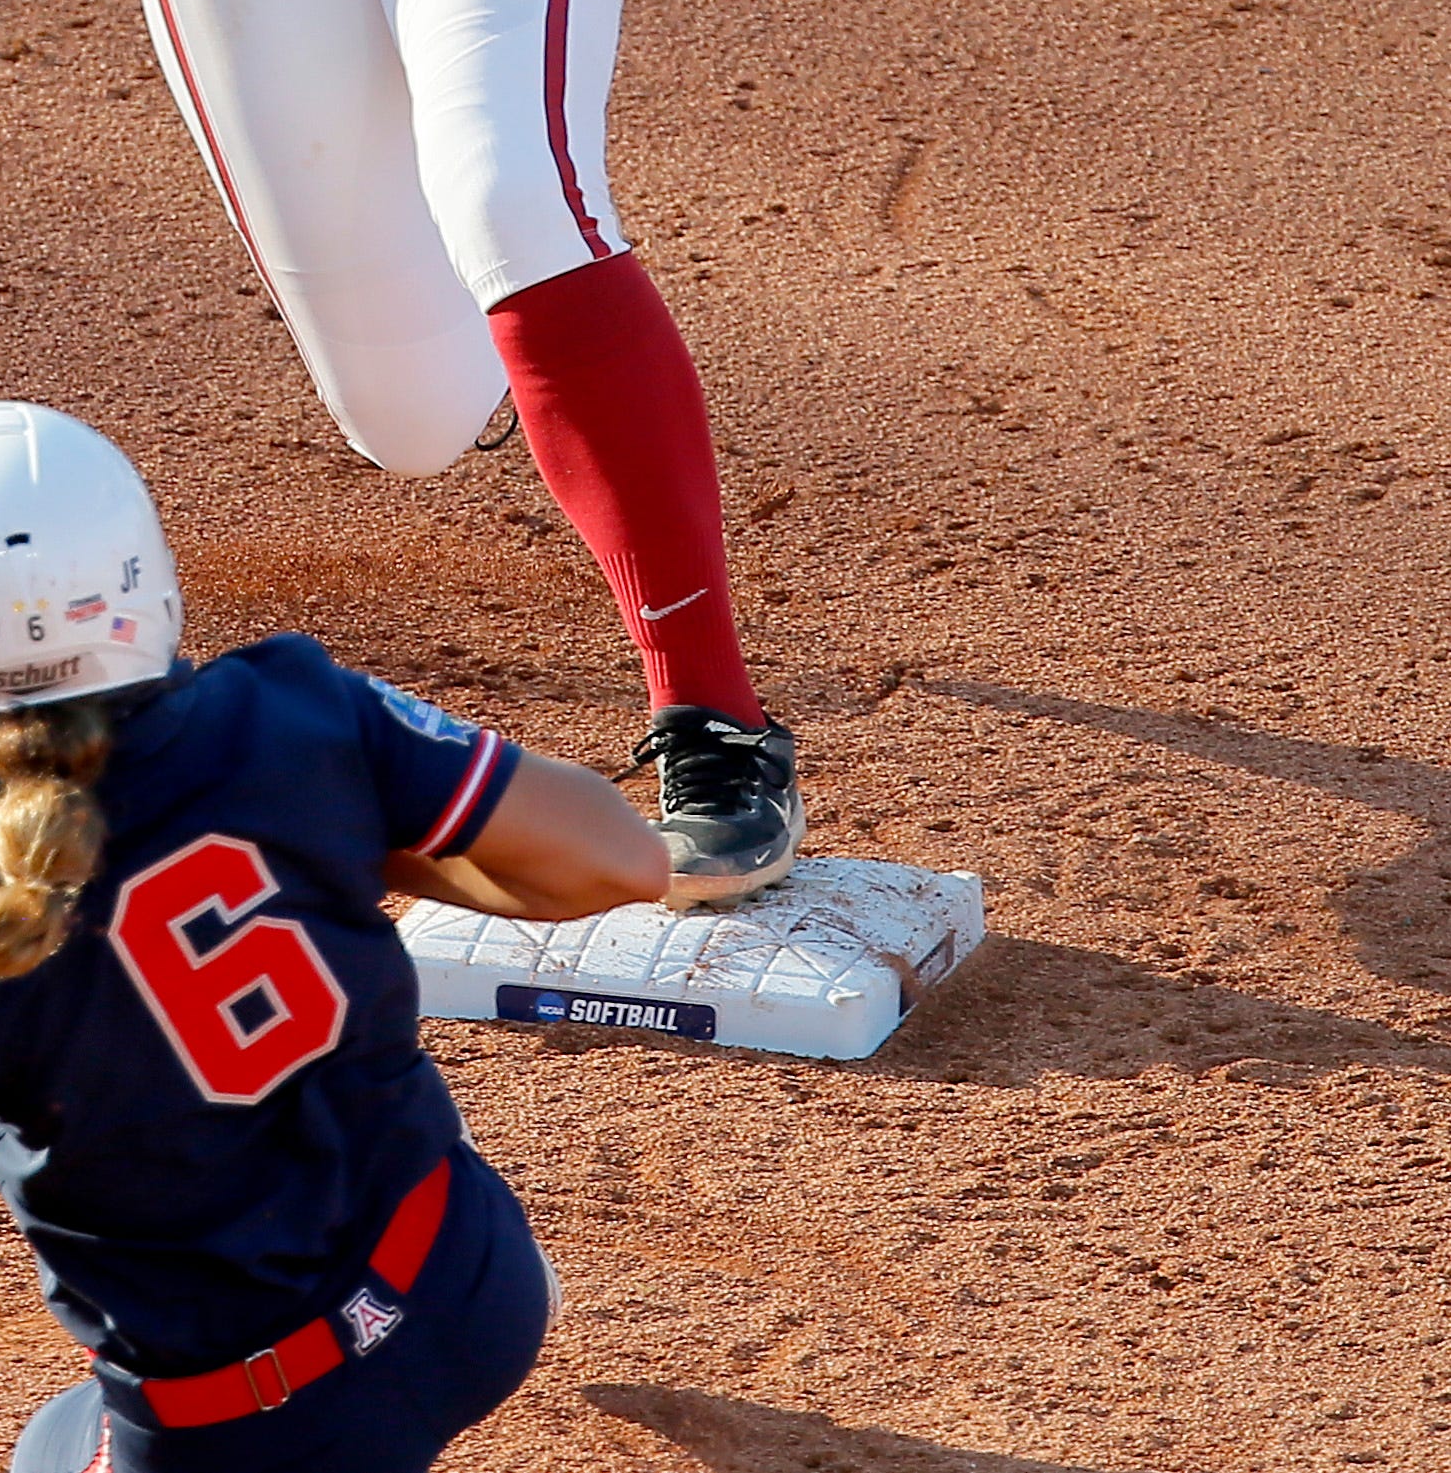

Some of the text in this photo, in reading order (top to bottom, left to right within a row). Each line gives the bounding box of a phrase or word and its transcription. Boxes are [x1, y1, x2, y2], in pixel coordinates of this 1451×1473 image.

[120, 555, 141, 593] JF
[28, 615, 45, 641] 6
[110, 834, 347, 1105] 6
[570, 999, 678, 1031] SOFTBALL
[342, 1288, 403, 1356] A
